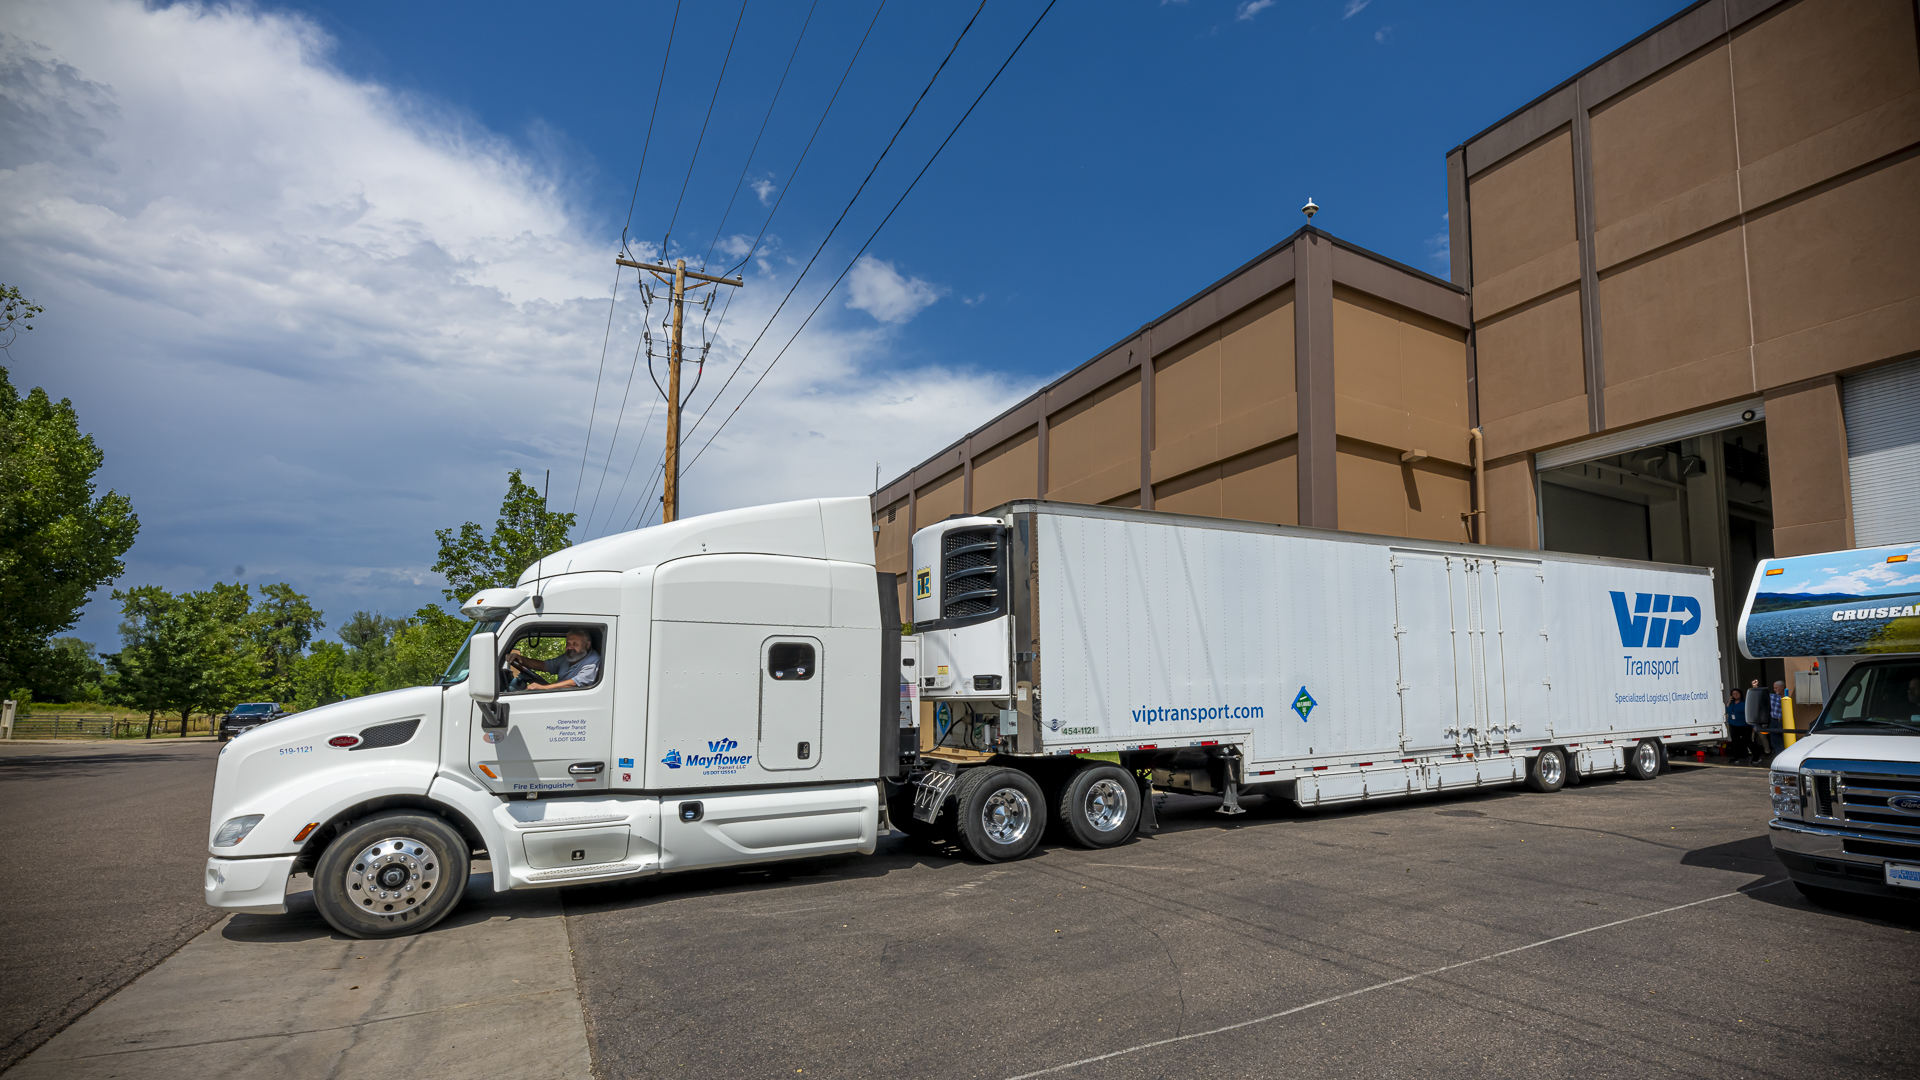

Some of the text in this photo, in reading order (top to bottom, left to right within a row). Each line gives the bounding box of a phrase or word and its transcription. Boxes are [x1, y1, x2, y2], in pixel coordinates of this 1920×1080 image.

[1623, 655, 1680, 680] Transport
[1614, 690, 1709, 704] Specialized Logistics Climate Control
[1131, 704, 1264, 725] viptransport.com
[1062, 726, 1096, 735] 454-1121
[279, 745, 313, 756] 519-1121
[685, 753, 753, 769] Mayflower
